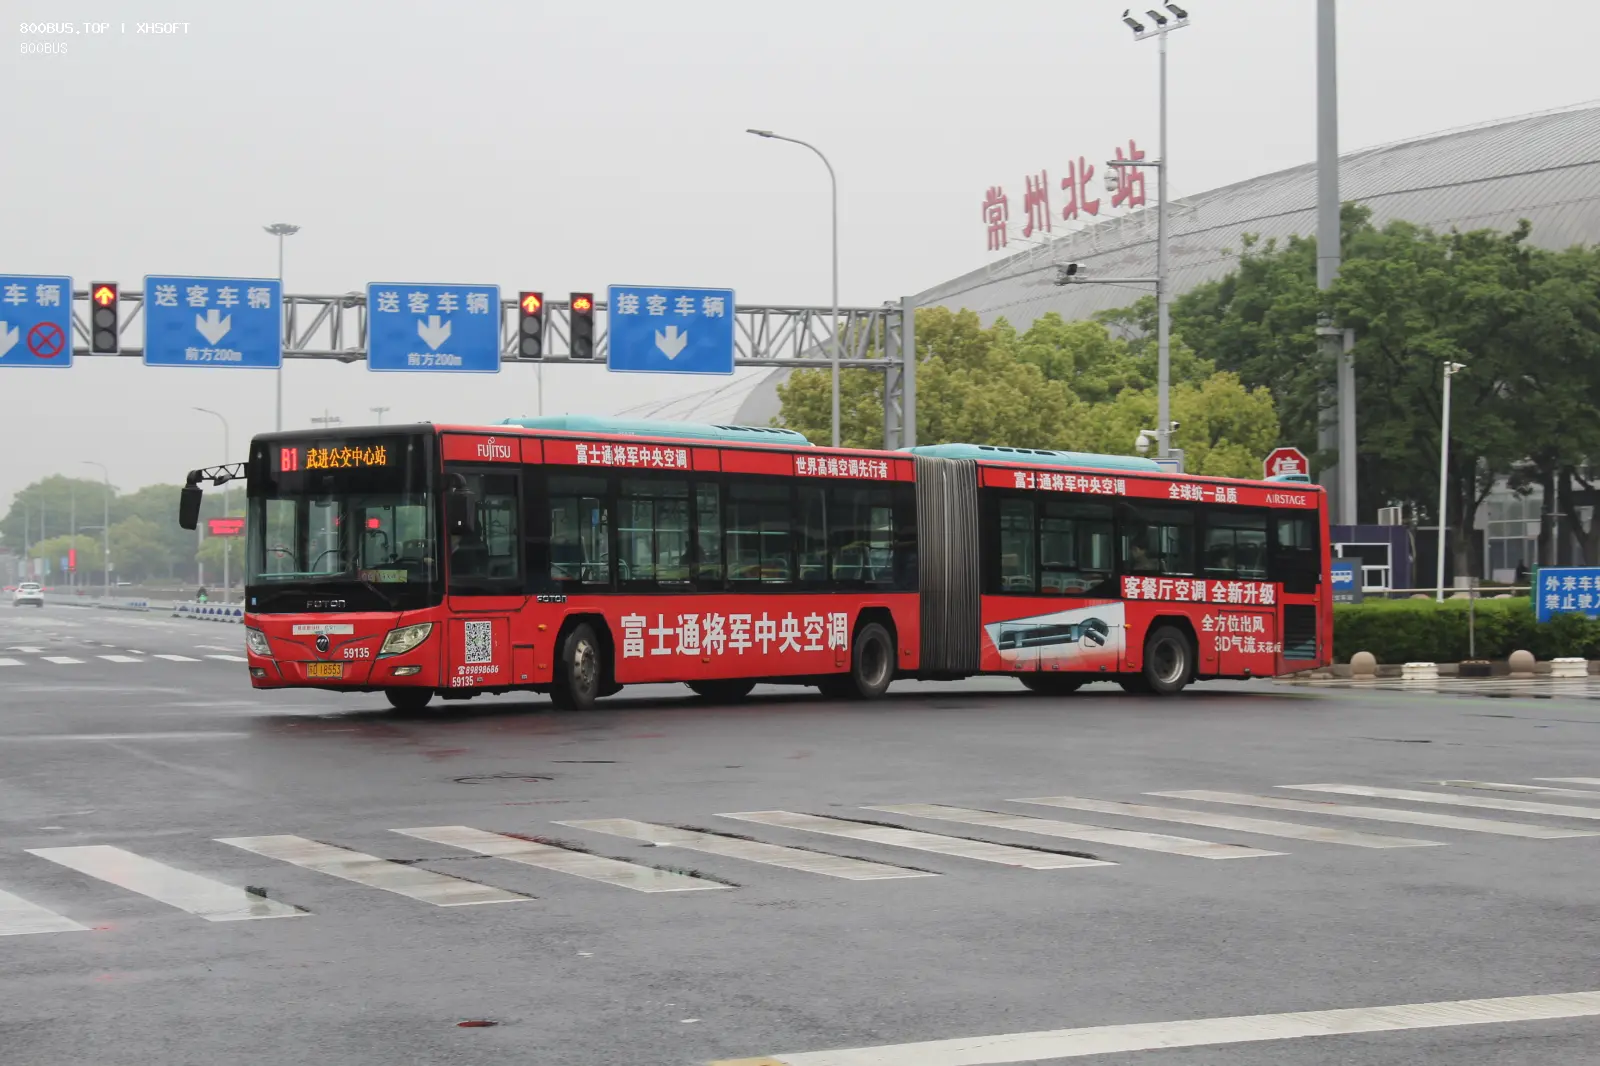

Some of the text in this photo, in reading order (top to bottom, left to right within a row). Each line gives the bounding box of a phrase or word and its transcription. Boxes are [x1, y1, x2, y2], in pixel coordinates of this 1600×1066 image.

[982, 138, 1146, 251] 常州北站
[3, 283, 60, 307] 车辆
[154, 285, 271, 310] 送客车辆
[377, 291, 490, 315] 送客车辆
[617, 293, 725, 318] 接客车辆
[185, 347, 242, 362] 前方200m
[407, 352, 462, 367] 前方200m
[281, 446, 387, 472] B1 武进公交中心站
[477, 437, 511, 461] FUJITSU
[575, 443, 688, 470] 富士通将军中央空调
[795, 456, 889, 480] 世界高端空调先行者
[1013, 471, 1126, 496] 富士通将军中央空调
[1168, 483, 1238, 504] 全球统一品质
[1265, 494, 1307, 507] AIRSTAGE
[1124, 576, 1276, 605] 客餐厅空调 全新升级
[621, 612, 849, 659] 富士通将军中央空调
[1202, 613, 1265, 634] 全方位出风
[343, 647, 370, 659] 59135
[1214, 635, 1256, 654] 3D气流
[452, 676, 474, 687] 59135
